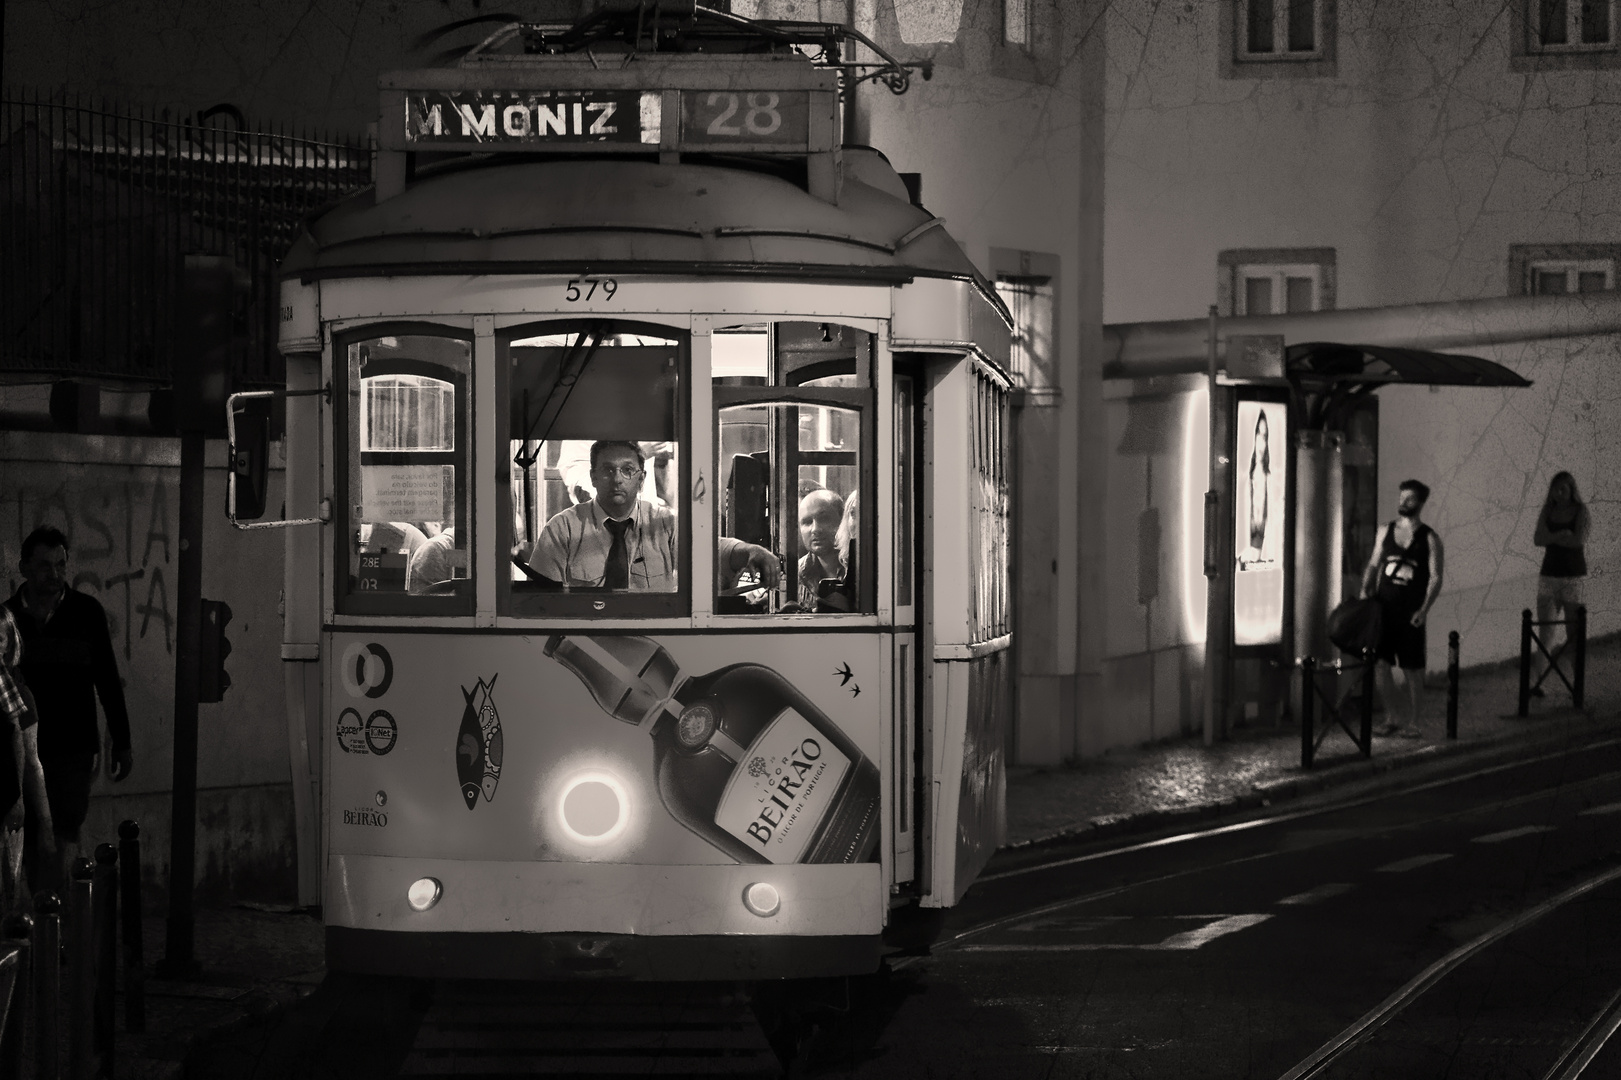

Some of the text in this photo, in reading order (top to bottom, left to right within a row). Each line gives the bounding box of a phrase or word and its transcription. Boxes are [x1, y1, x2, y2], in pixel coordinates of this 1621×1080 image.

[461, 101, 618, 137] MONIZ
[706, 91, 782, 136] 28
[565, 278, 618, 302] 579
[361, 557, 380, 568] 28E
[746, 738, 822, 848] BEIRÃO
[758, 756, 789, 804] LICOR
[802, 761, 828, 800] PORTUGAL
[343, 808, 388, 828] BEIRÃO
